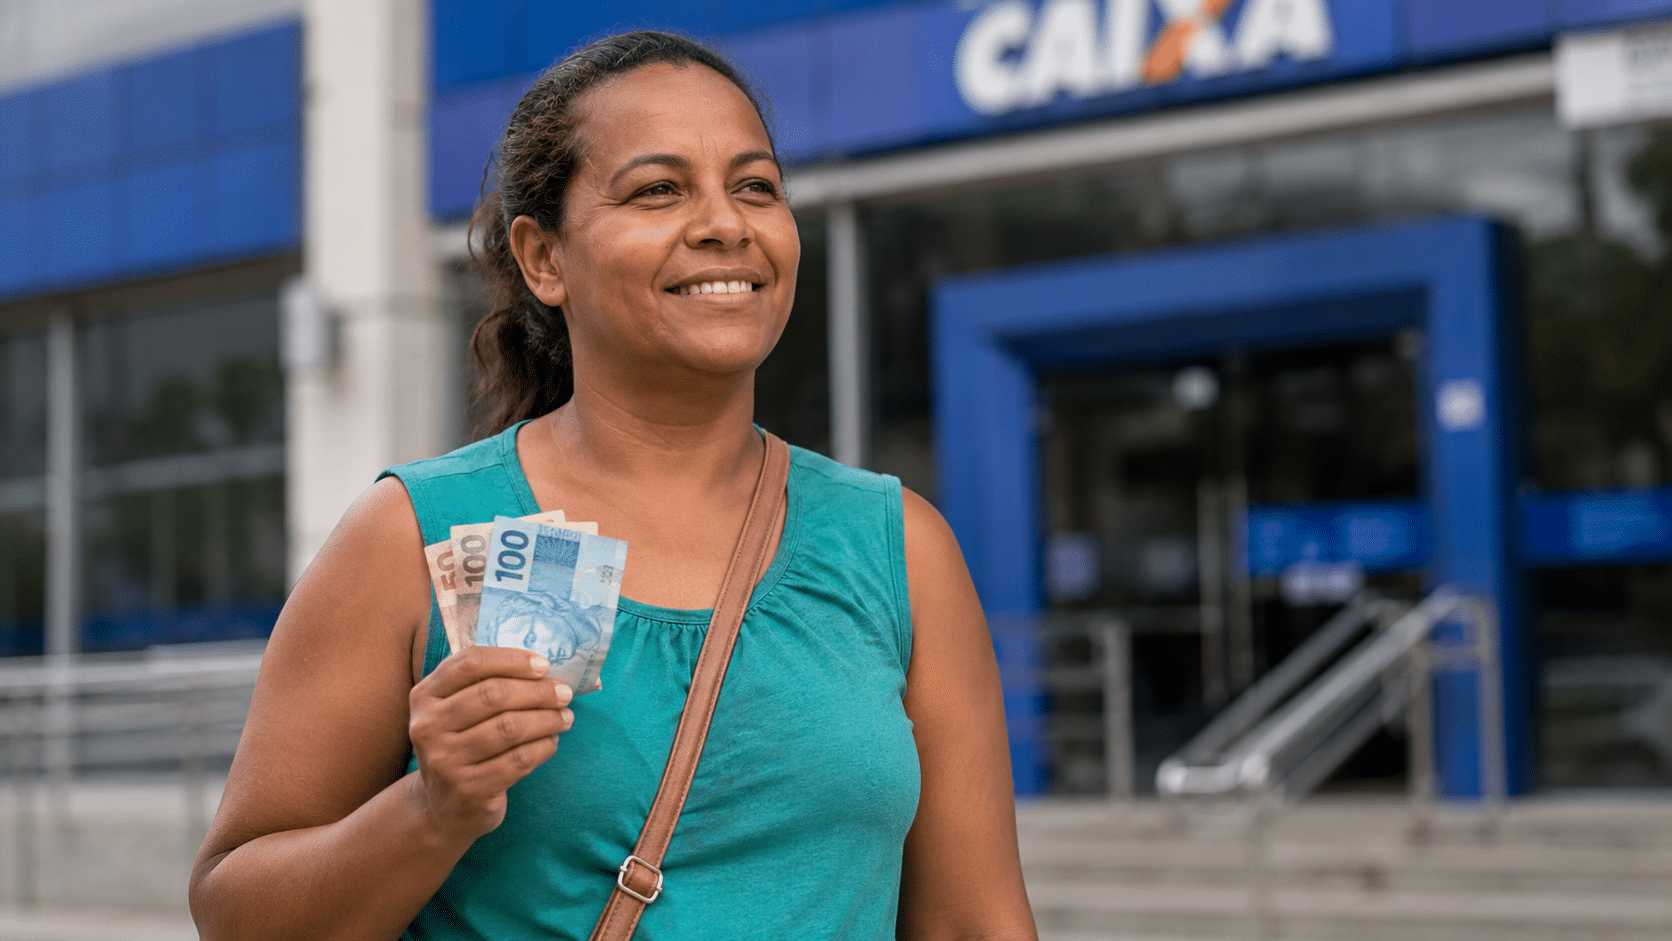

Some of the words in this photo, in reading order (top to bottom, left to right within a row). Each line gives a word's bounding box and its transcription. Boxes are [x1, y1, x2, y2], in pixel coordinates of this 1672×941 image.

[957, 0, 1332, 114] CAIXA
[460, 534, 486, 587] 100
[495, 530, 529, 582] 100
